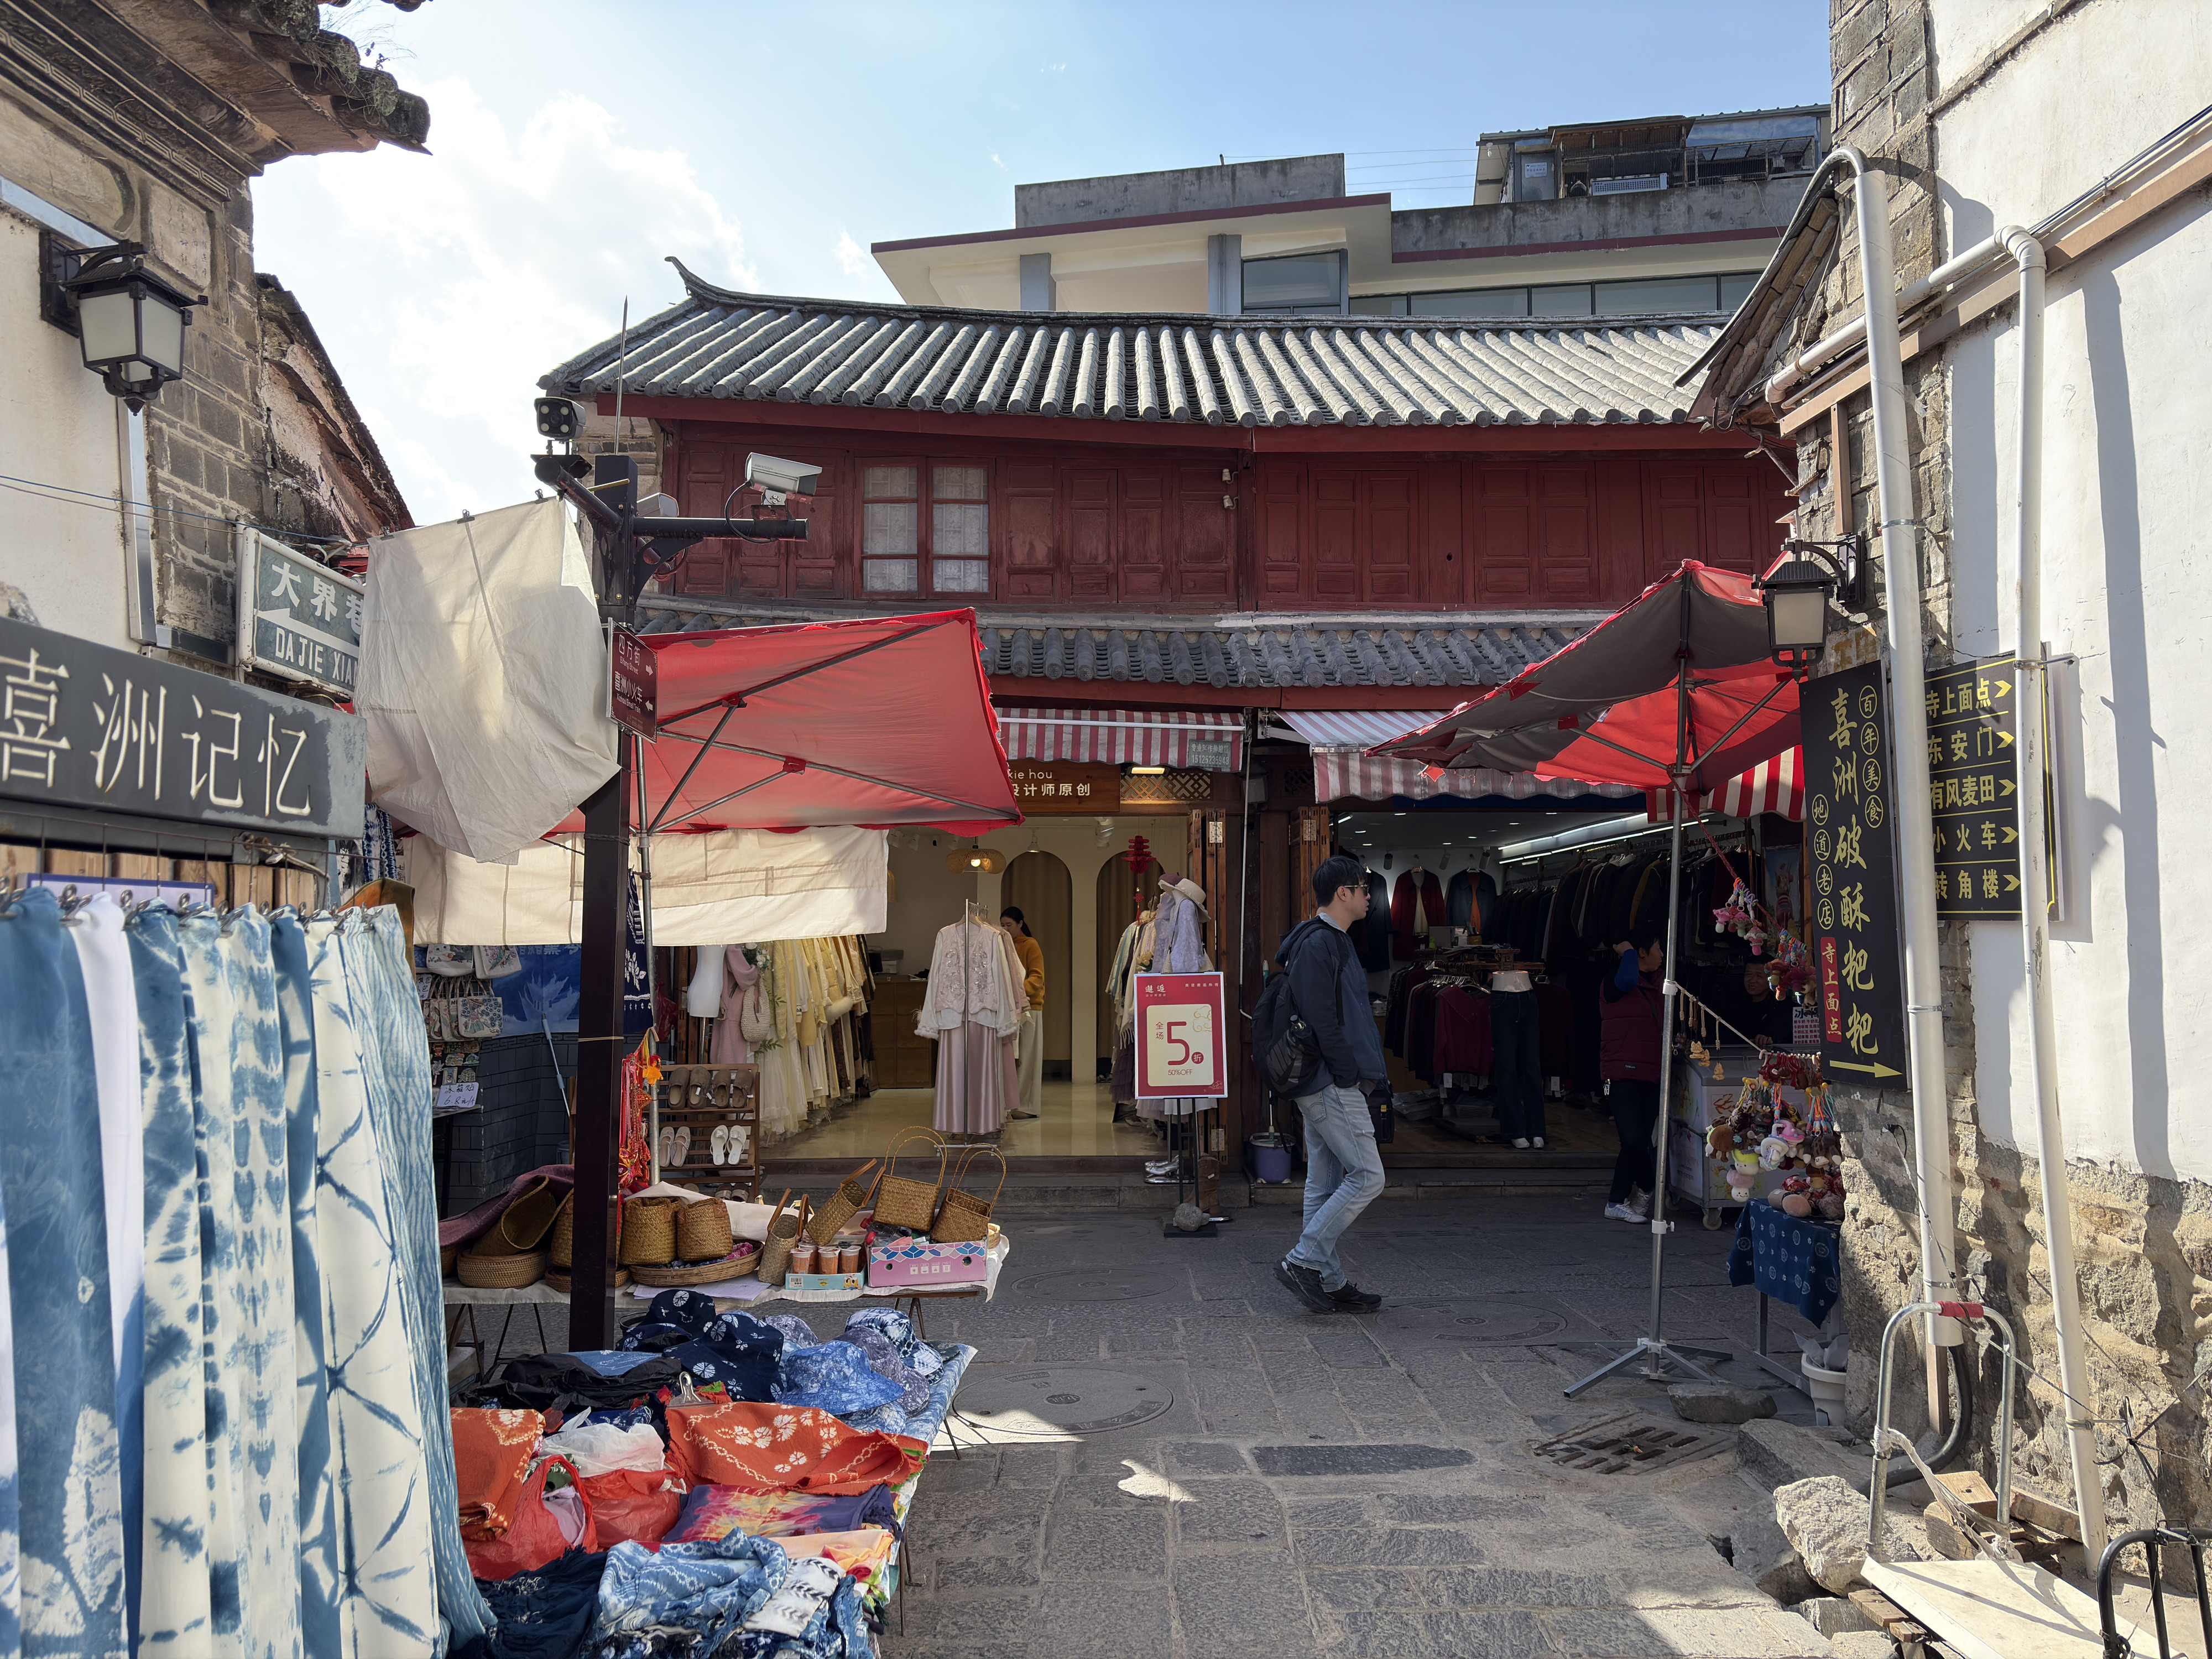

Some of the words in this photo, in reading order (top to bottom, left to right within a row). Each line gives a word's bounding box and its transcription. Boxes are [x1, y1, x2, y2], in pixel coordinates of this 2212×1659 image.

[272, 562, 364, 635] 大界巷
[619, 634, 640, 666] 四方街
[620, 656, 629, 670] Sifang
[629, 663, 639, 675] Street
[615, 671, 643, 704] 喜洲小火车
[617, 692, 626, 705] Xizhou
[1926, 678, 1991, 718] 寺上面点
[0, 648, 311, 817] 喜洲记忆
[1928, 726, 1992, 764] 东安门
[1029, 769, 1052, 779] hou
[1860, 691, 1882, 823] 百年美食
[1930, 775, 1995, 810] 有风麦田
[1933, 821, 1997, 853] 小火车
[1813, 799, 1833, 927] 地道老店
[1829, 688, 1879, 1055] 喜洲破酥粑粑
[1935, 869, 1999, 899] 转角楼
[1145, 984, 1166, 993] 邂逅
[1822, 942, 1842, 1036] 寺上面点
[1155, 1021, 1164, 1040] 全场
[1167, 1021, 1190, 1066] 5
[1193, 1053, 1202, 1062] 折
